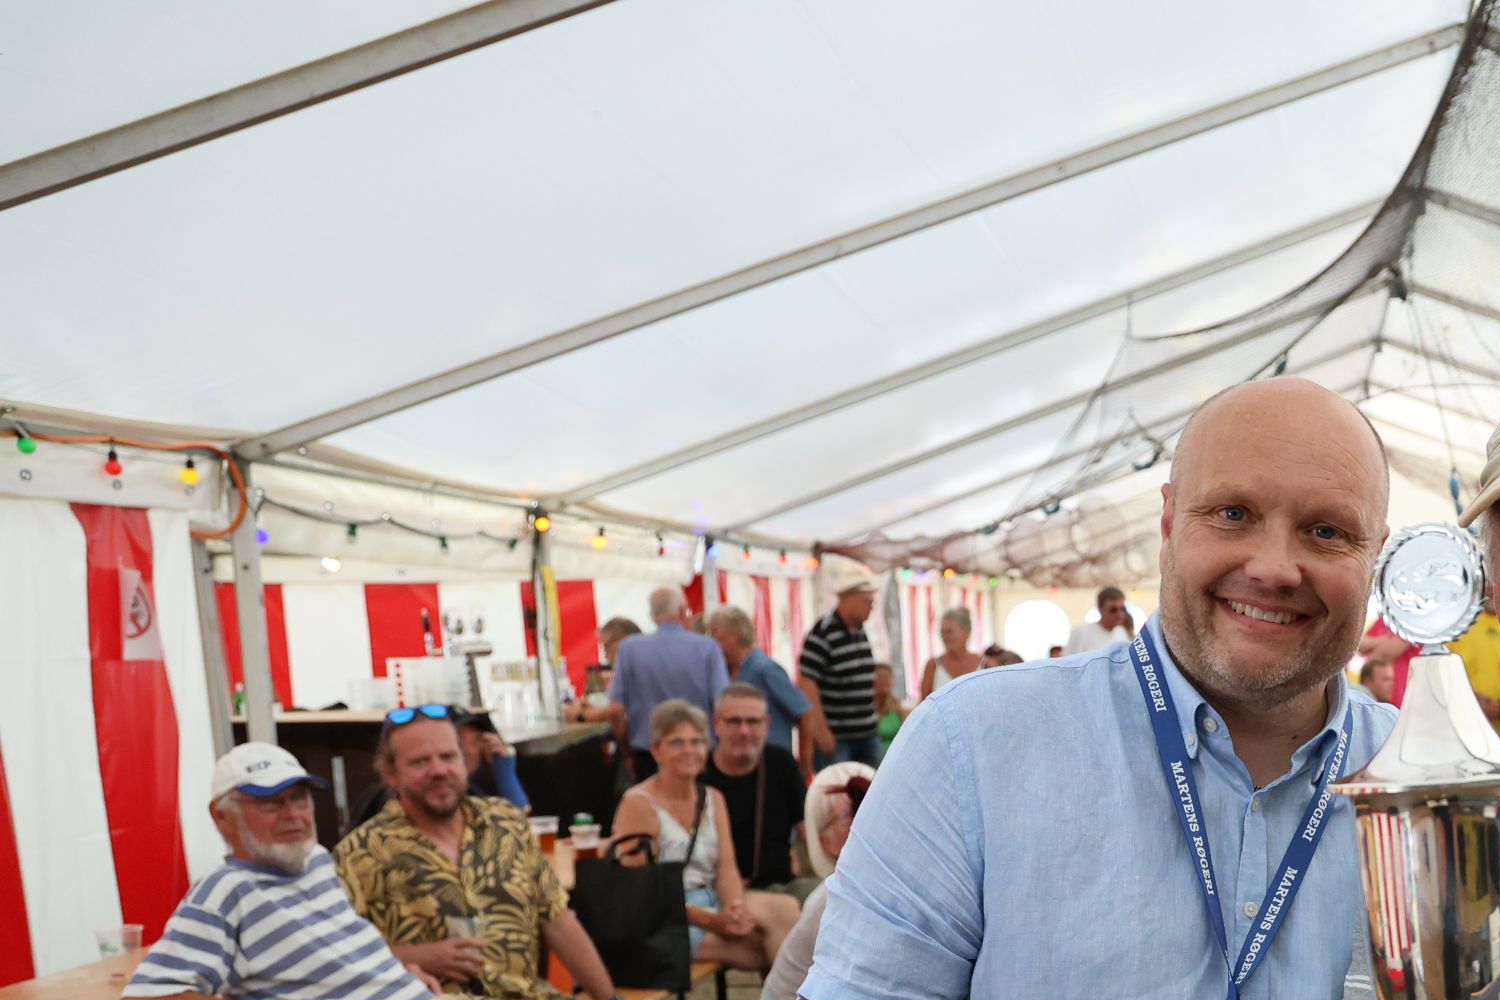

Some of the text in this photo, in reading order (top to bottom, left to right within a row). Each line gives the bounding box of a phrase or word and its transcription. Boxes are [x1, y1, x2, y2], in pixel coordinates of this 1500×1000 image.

[1142, 664, 1167, 713] RØGERI
[1170, 760, 1215, 896] MARTENS RØGERI
[1302, 728, 1348, 842] MARTEN RØGERI
[1260, 866, 1298, 931] MARTENS
